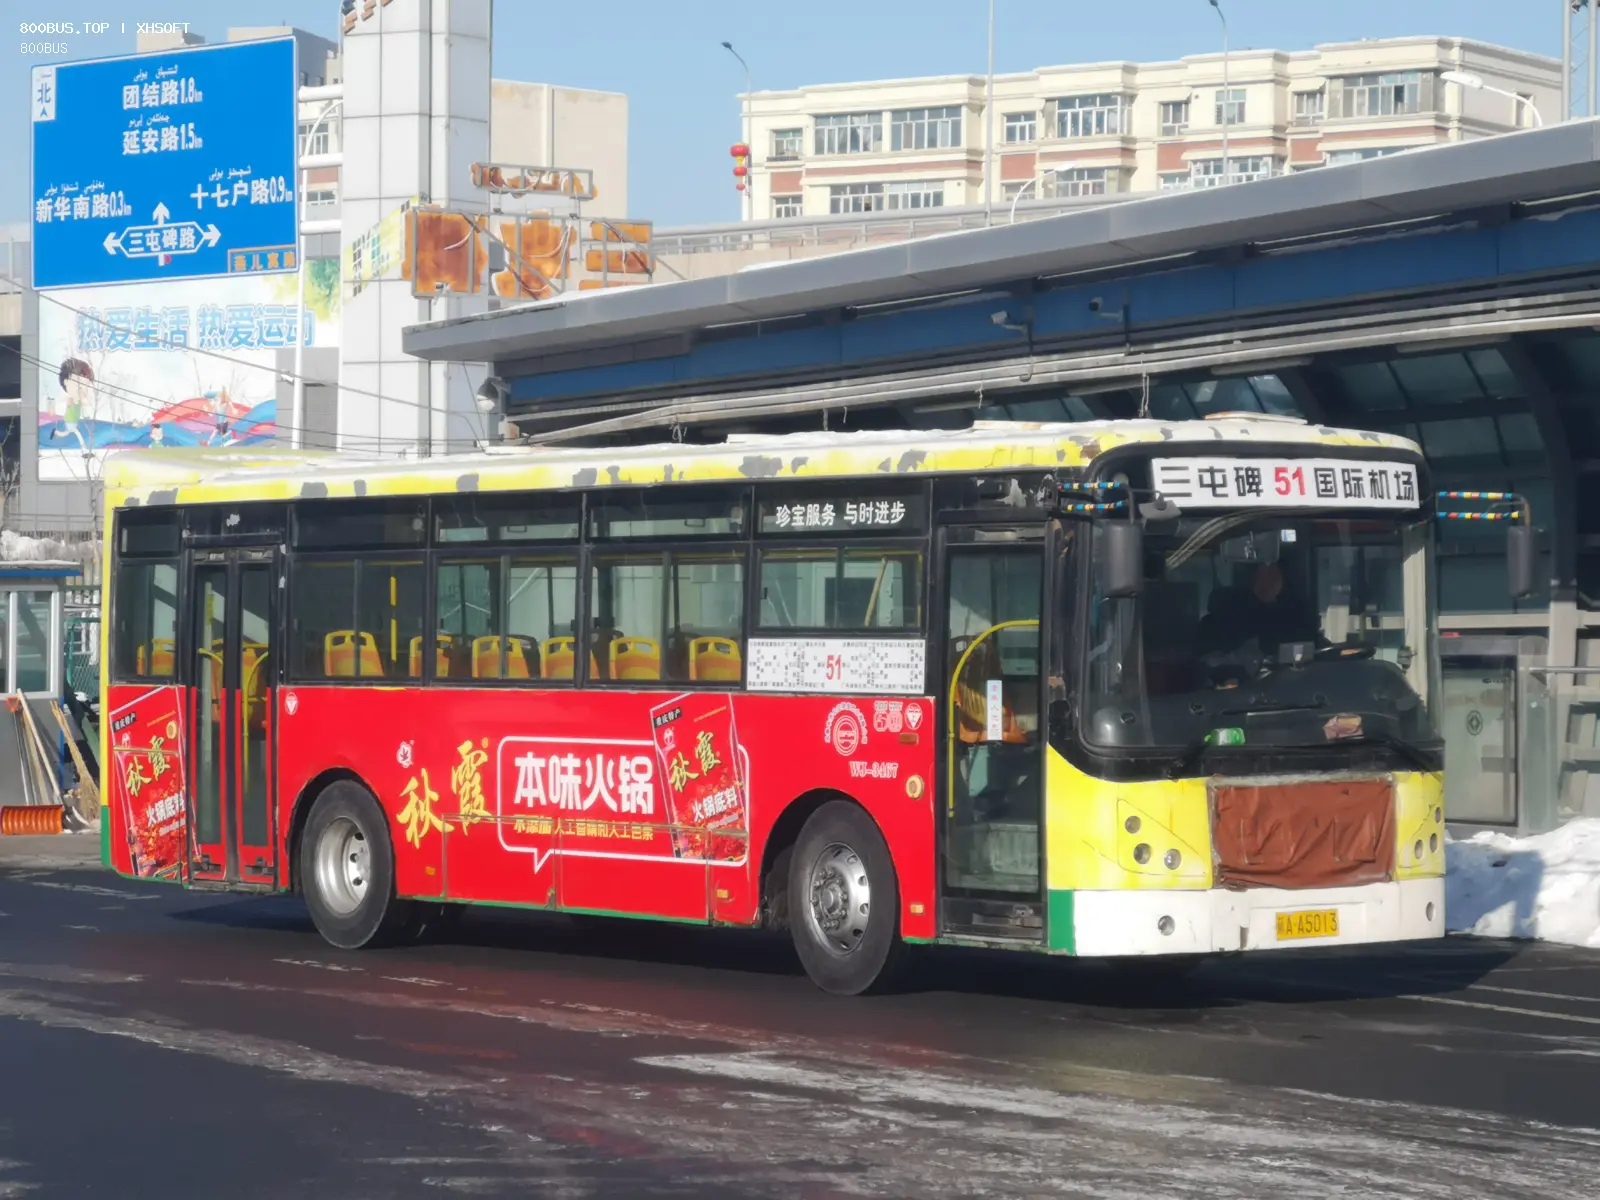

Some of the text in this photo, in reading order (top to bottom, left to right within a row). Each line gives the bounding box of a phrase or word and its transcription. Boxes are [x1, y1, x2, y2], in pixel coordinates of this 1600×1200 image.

[37, 82, 52, 104] 北
[128, 226, 196, 252] 三屯碑路
[76, 303, 315, 350] 热爱生活 热爱运动
[1160, 465, 1415, 502] 三屯碑 51 国际机场
[776, 501, 906, 527] 珍宝服务 与时进步
[826, 654, 842, 680] 51
[513, 750, 654, 815] 本味火锅
[692, 786, 739, 823] 火锅底料
